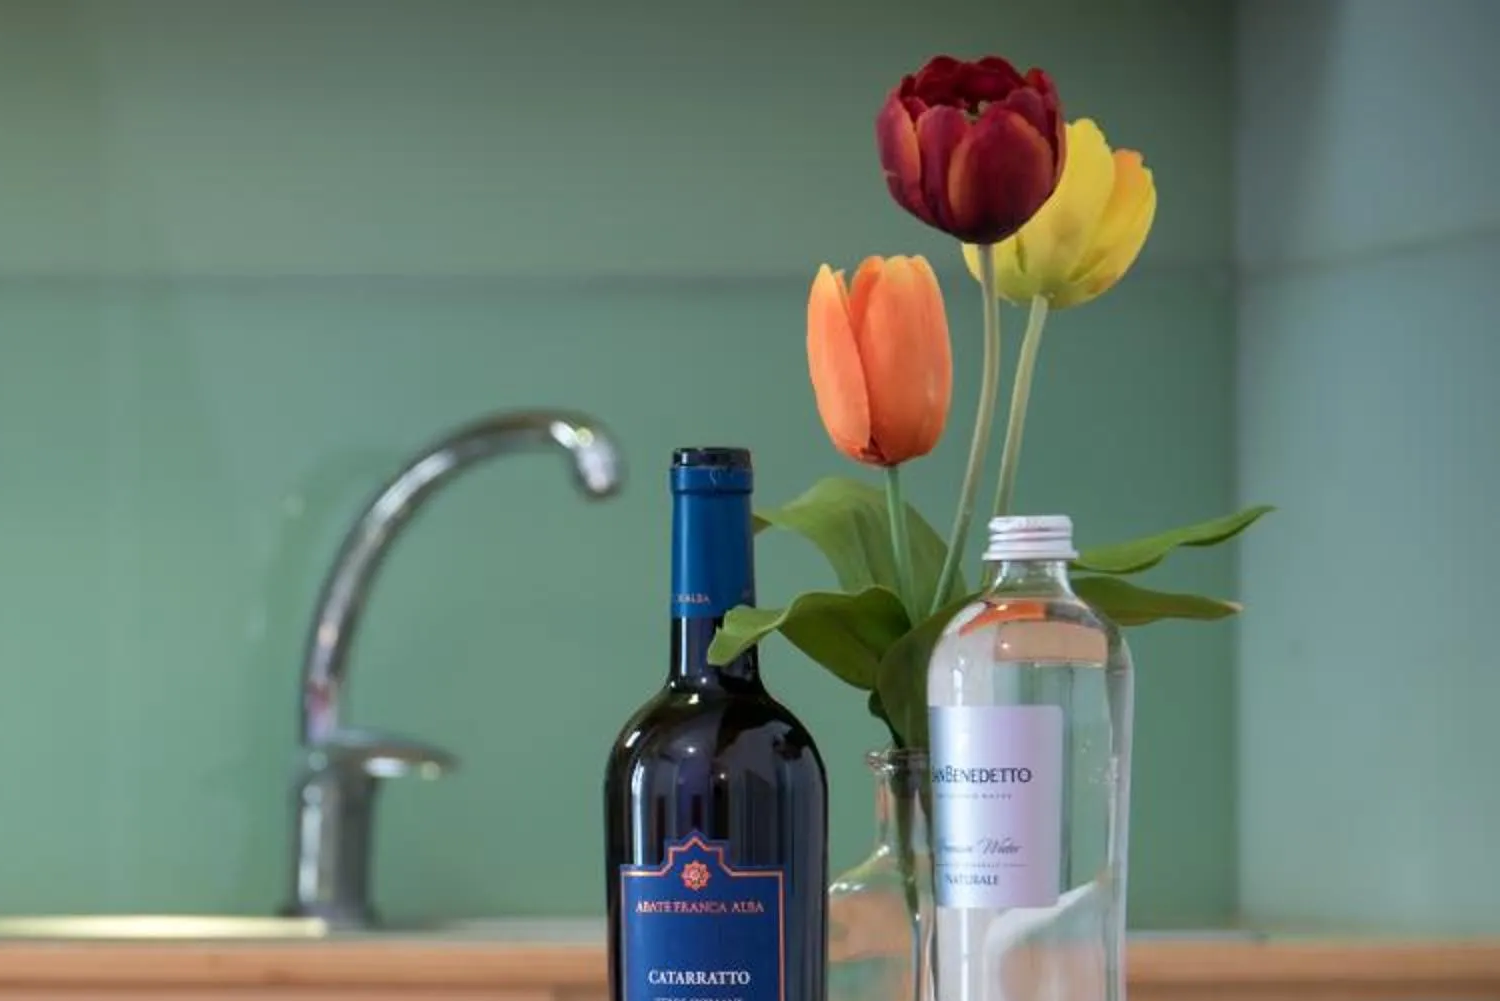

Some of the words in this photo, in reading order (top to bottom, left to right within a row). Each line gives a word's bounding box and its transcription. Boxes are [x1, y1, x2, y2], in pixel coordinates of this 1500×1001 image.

[944, 873, 1000, 886] NATURALE
[674, 900, 727, 914] FRANCA
[731, 900, 765, 914] ALBA
[647, 970, 751, 986] CATARRATTO
